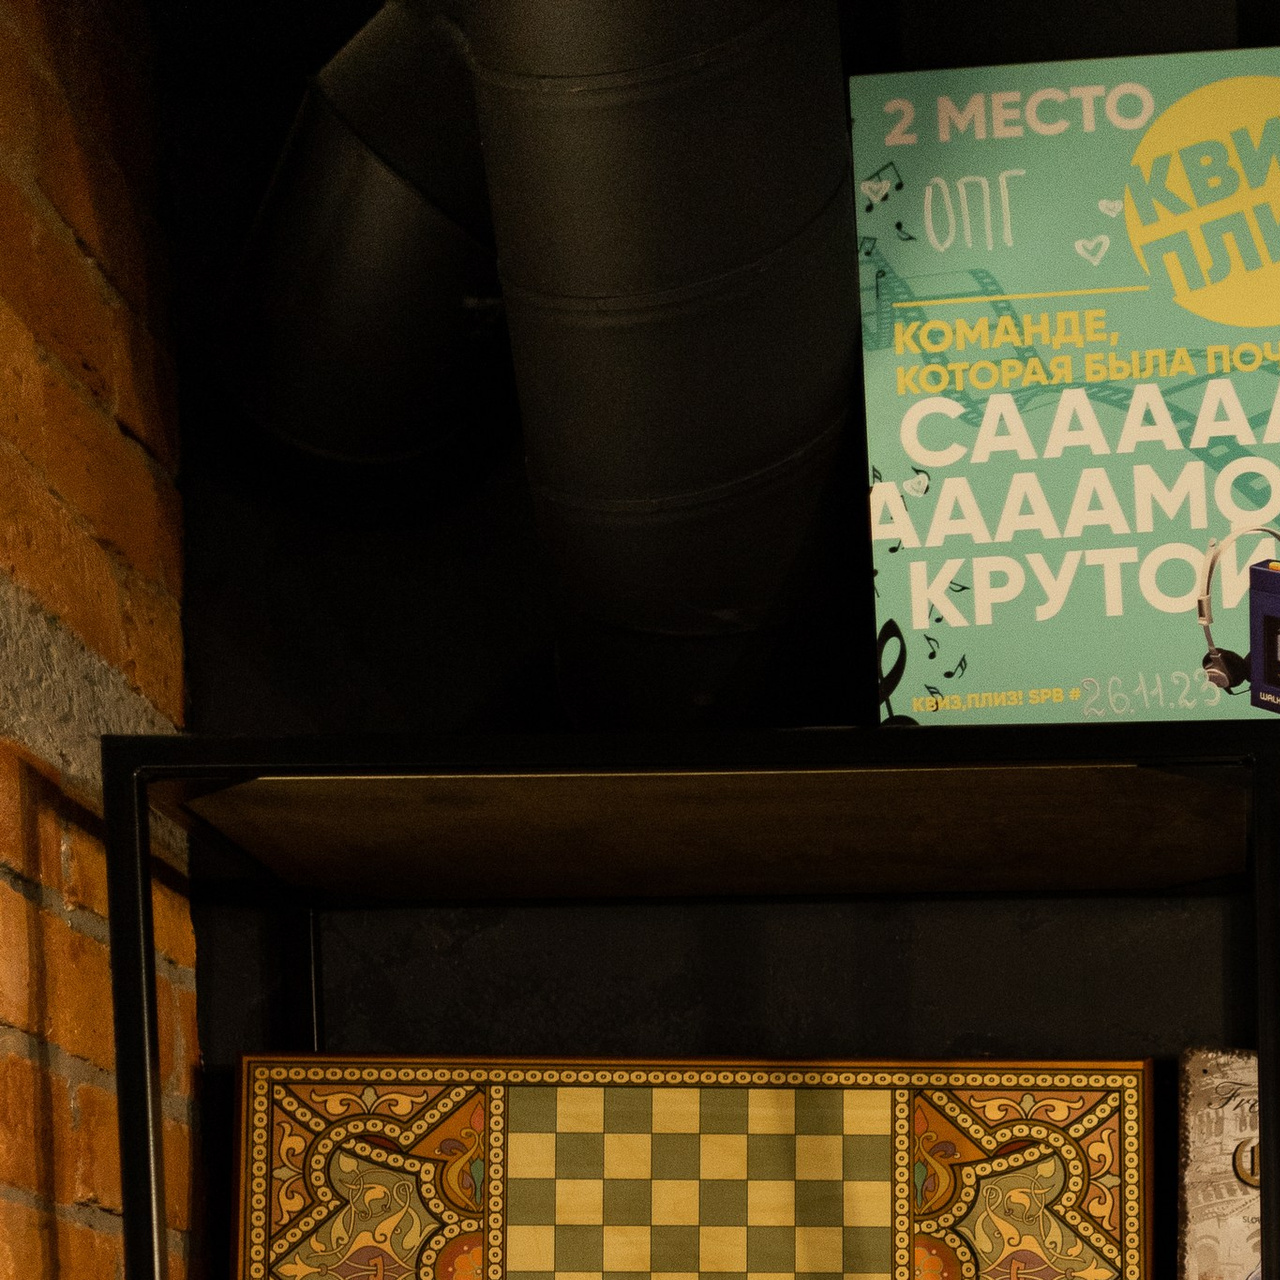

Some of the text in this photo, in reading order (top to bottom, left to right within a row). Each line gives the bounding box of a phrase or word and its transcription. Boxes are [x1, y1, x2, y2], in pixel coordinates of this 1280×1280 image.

[884, 83, 1156, 146] 2 МЕСТО
[924, 169, 1027, 252] ОПГ
[892, 309, 1121, 355] КОМАНДЕ,
[896, 354, 1075, 396] КОТОРАЯ
[1085, 347, 1196, 384] БЫЛА
